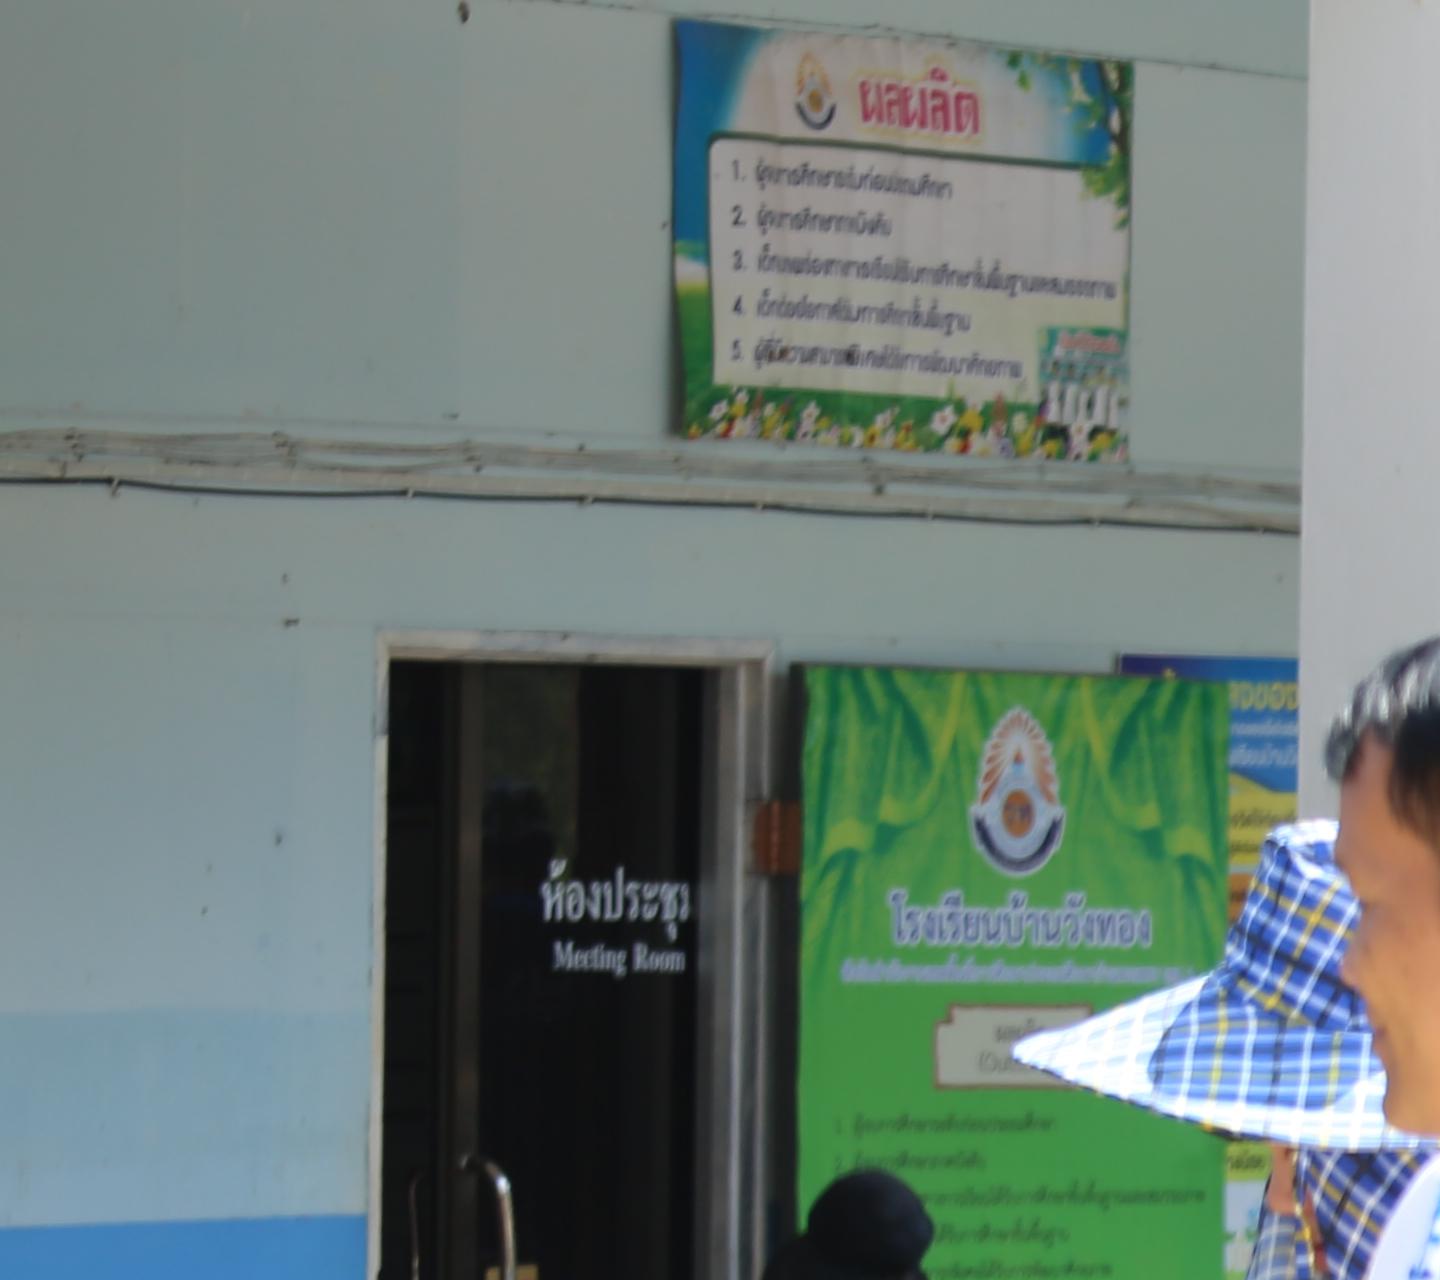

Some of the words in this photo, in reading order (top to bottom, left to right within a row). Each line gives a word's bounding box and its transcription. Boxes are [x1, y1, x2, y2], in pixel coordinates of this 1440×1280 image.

[858, 65, 981, 136] ผลผลิต
[888, 888, 1152, 948] โรงเรียนบ้านวังทอง
[553, 940, 628, 978] Meeting
[632, 941, 686, 971] Room
